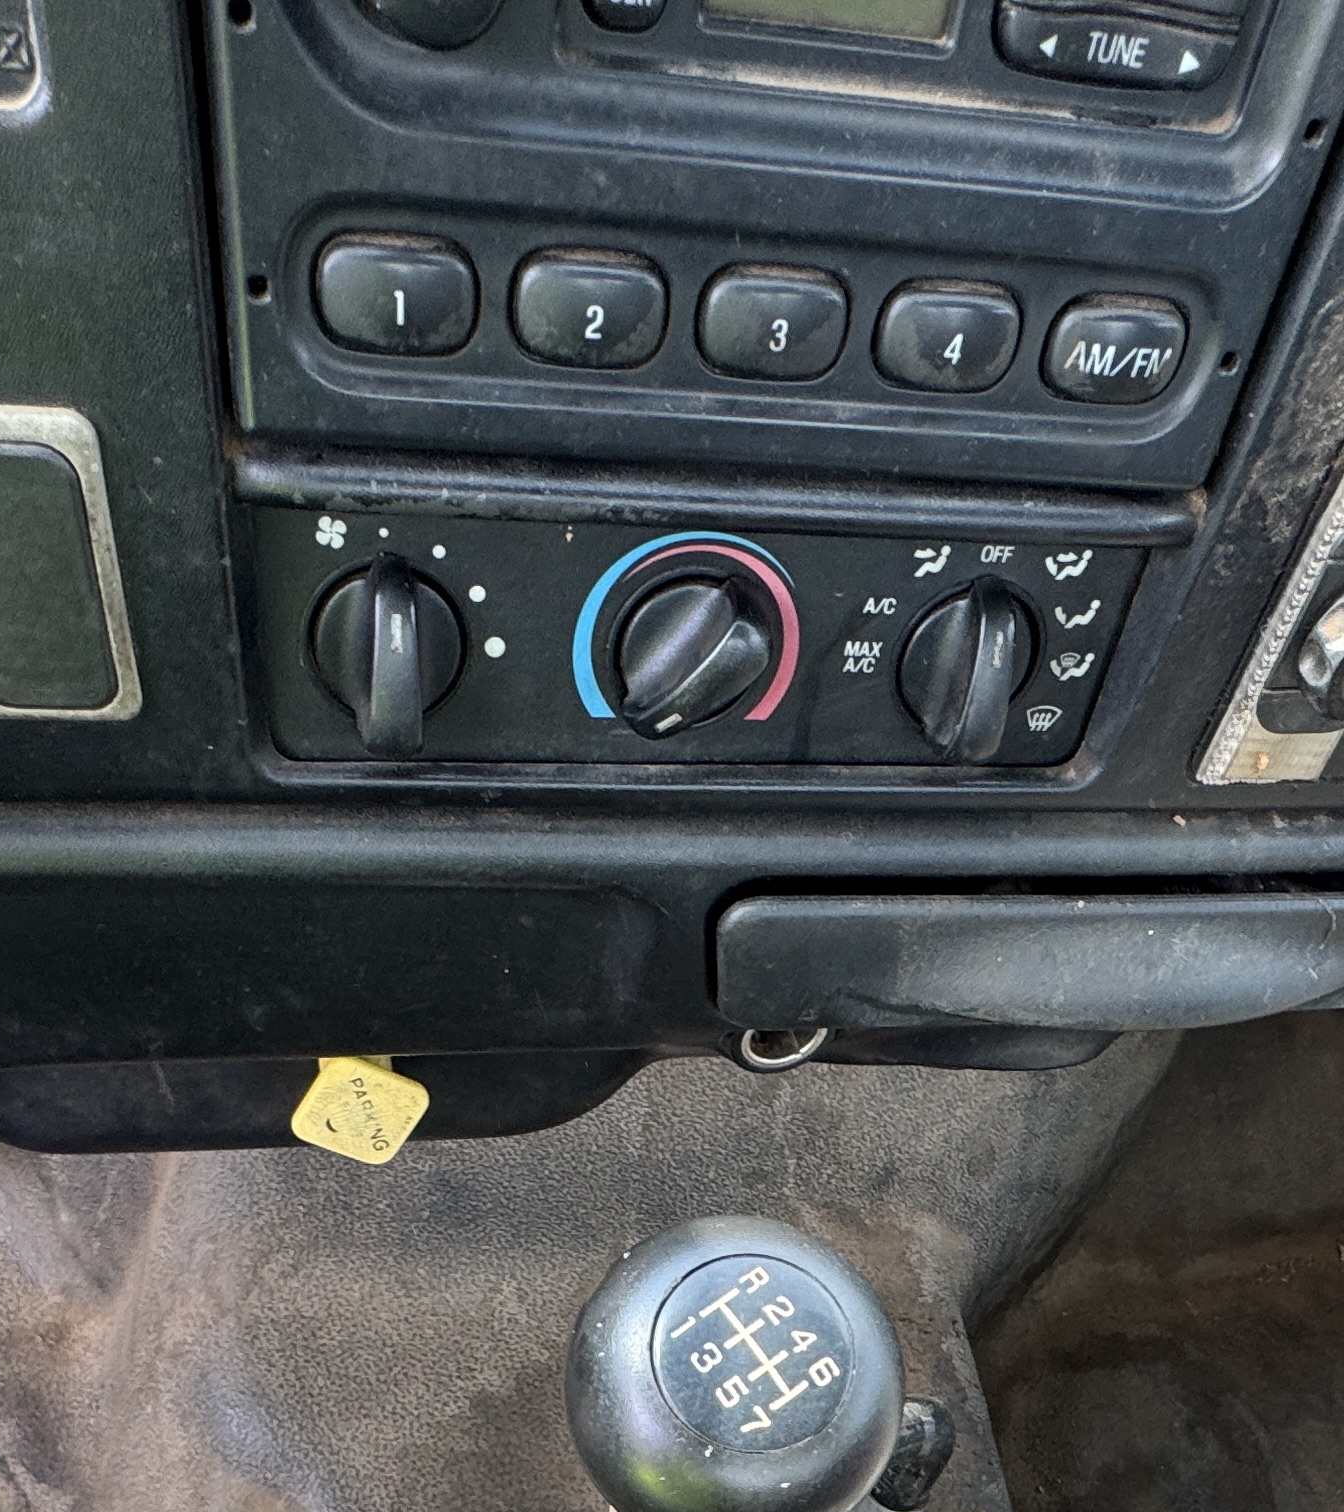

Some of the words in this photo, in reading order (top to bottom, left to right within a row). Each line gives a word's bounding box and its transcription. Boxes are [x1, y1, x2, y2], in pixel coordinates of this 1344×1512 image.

[1086, 31, 1150, 69] TUNE
[393, 289, 405, 326] 1
[584, 305, 605, 340] 2
[769, 318, 789, 352] 3
[943, 333, 964, 366] 4
[980, 545, 1016, 564] OFF
[862, 597, 898, 615] A/C
[843, 640, 884, 658] MAX
[842, 658, 876, 674] A/C
[738, 1266, 770, 1294] R
[761, 1295, 796, 1326] 2
[670, 1315, 696, 1338] 1
[790, 1329, 818, 1354] 4
[690, 1341, 723, 1374] 3
[807, 1356, 841, 1388] 6
[714, 1374, 750, 1409] 5
[739, 1405, 773, 1434] 7
